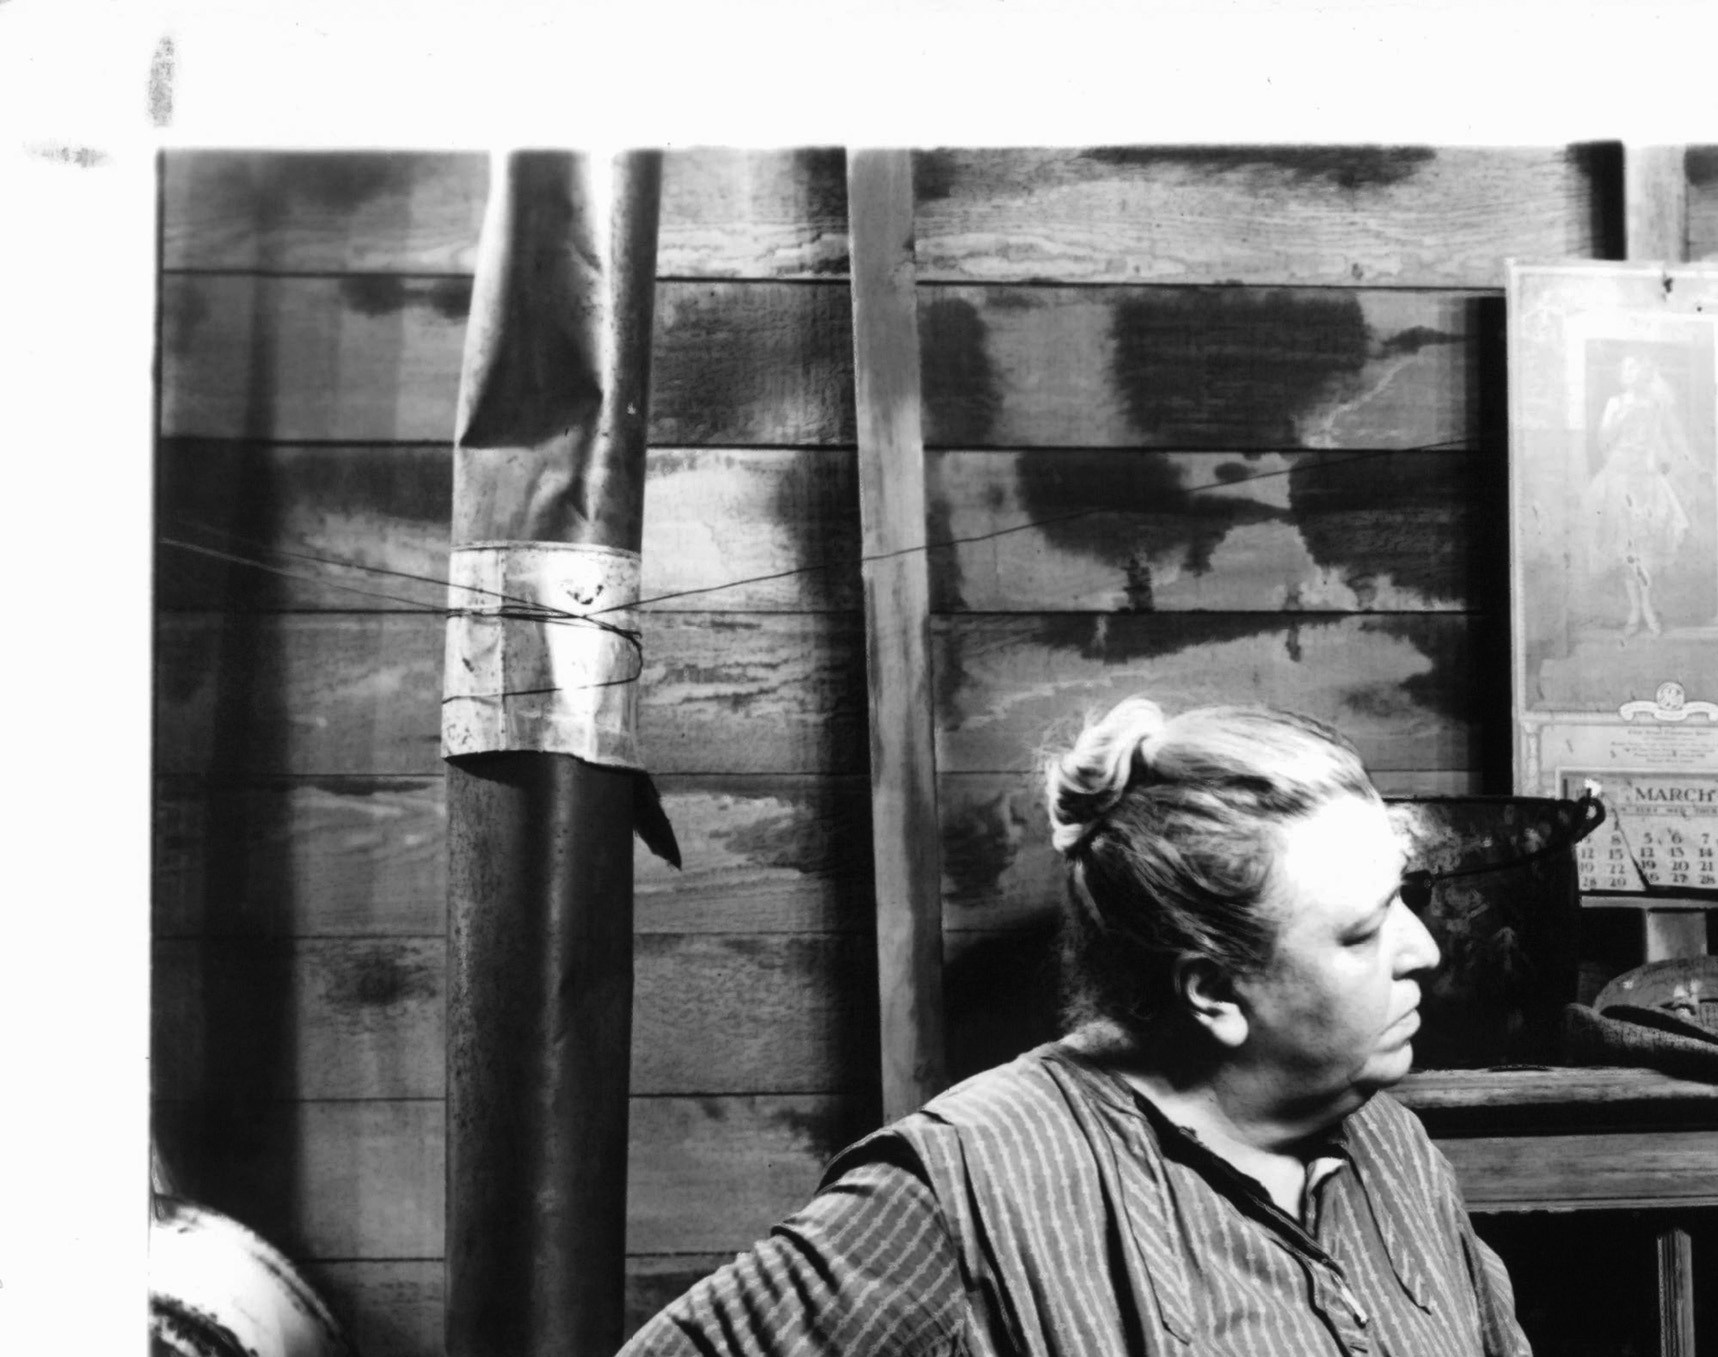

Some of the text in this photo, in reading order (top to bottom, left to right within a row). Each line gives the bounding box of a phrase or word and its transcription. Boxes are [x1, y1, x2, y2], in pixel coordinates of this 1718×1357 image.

[1636, 787, 1714, 802] MARCH
[1644, 832, 1653, 844] 5
[1671, 832, 1682, 844] 6
[1702, 832, 1710, 844] 7
[1640, 847, 1655, 858] 12
[1699, 847, 1713, 858] 14
[1607, 863, 1625, 874] 22
[1641, 860, 1657, 870] 19
[1671, 861, 1689, 872] 20
[1701, 861, 1713, 872] 21
[1671, 871, 1688, 883] 27
